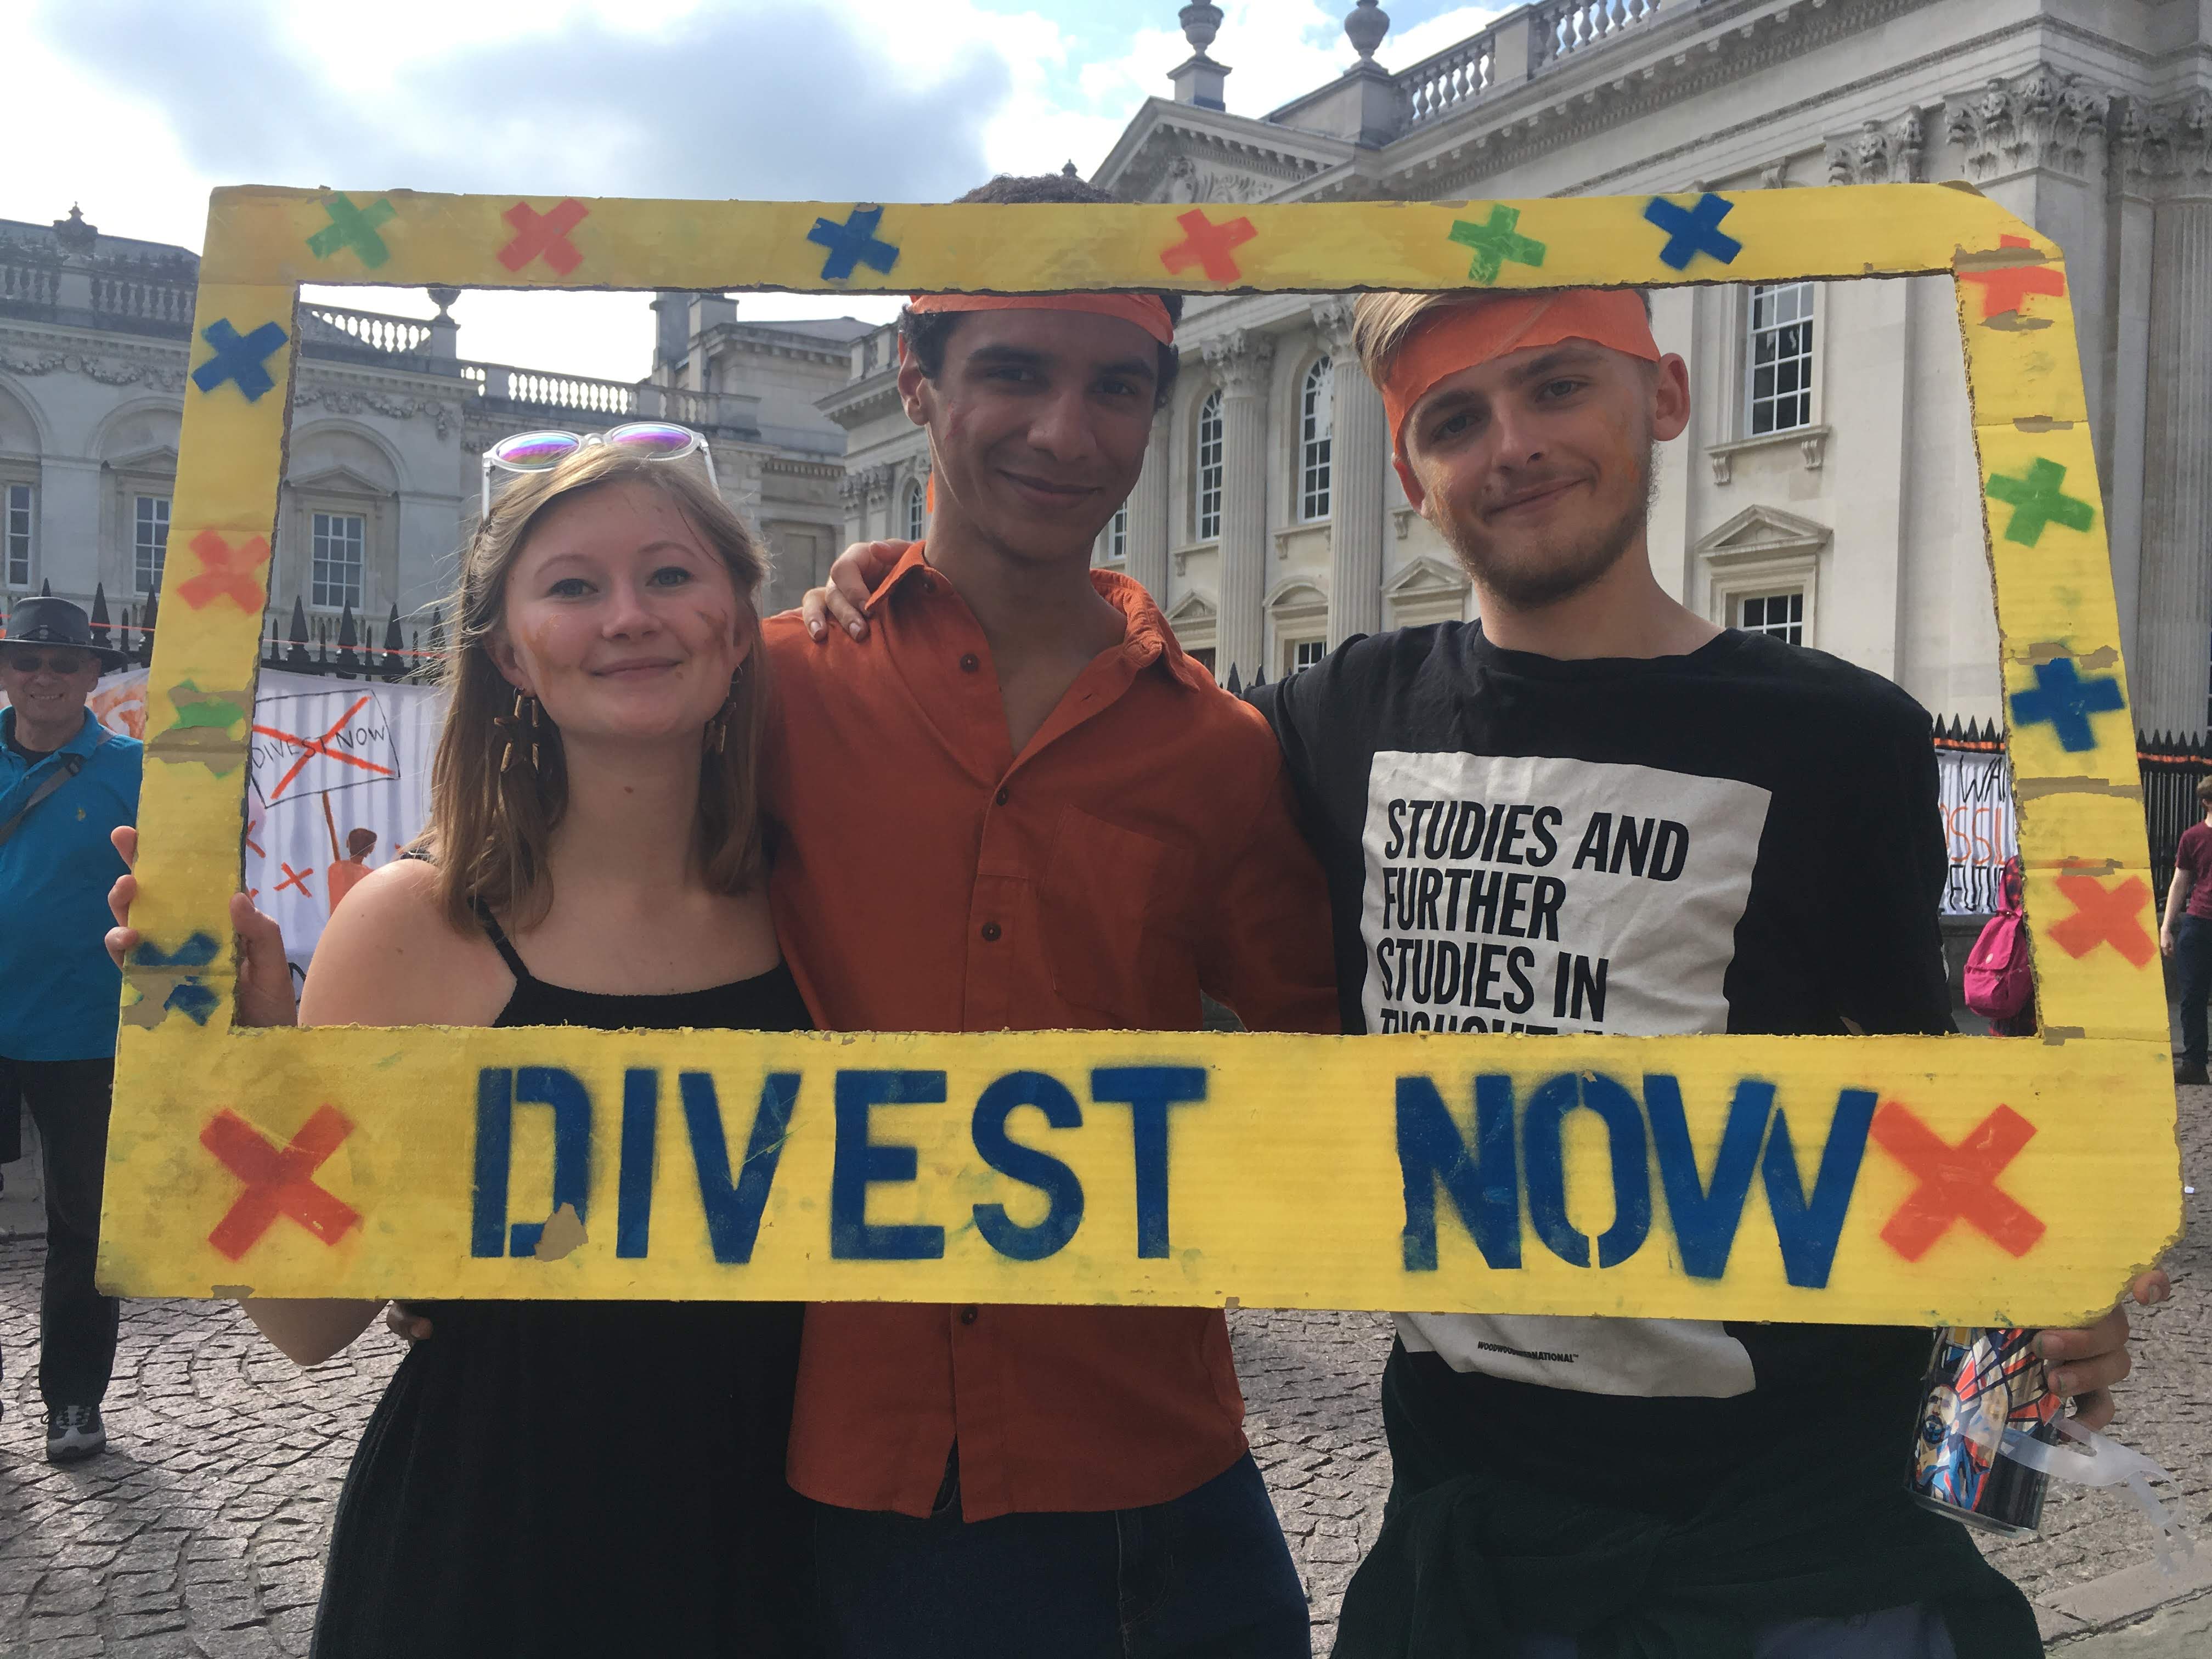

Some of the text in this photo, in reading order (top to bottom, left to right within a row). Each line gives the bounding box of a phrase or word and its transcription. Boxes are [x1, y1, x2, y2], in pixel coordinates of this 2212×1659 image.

[251, 725, 385, 769] DIVEST NOW
[1384, 798, 1690, 882] STUDIES AND
[1382, 867, 1567, 942] FURTHER
[1376, 937, 1610, 1022] STUDIES IN
[470, 1066, 1880, 1290] DIVEST NOW
